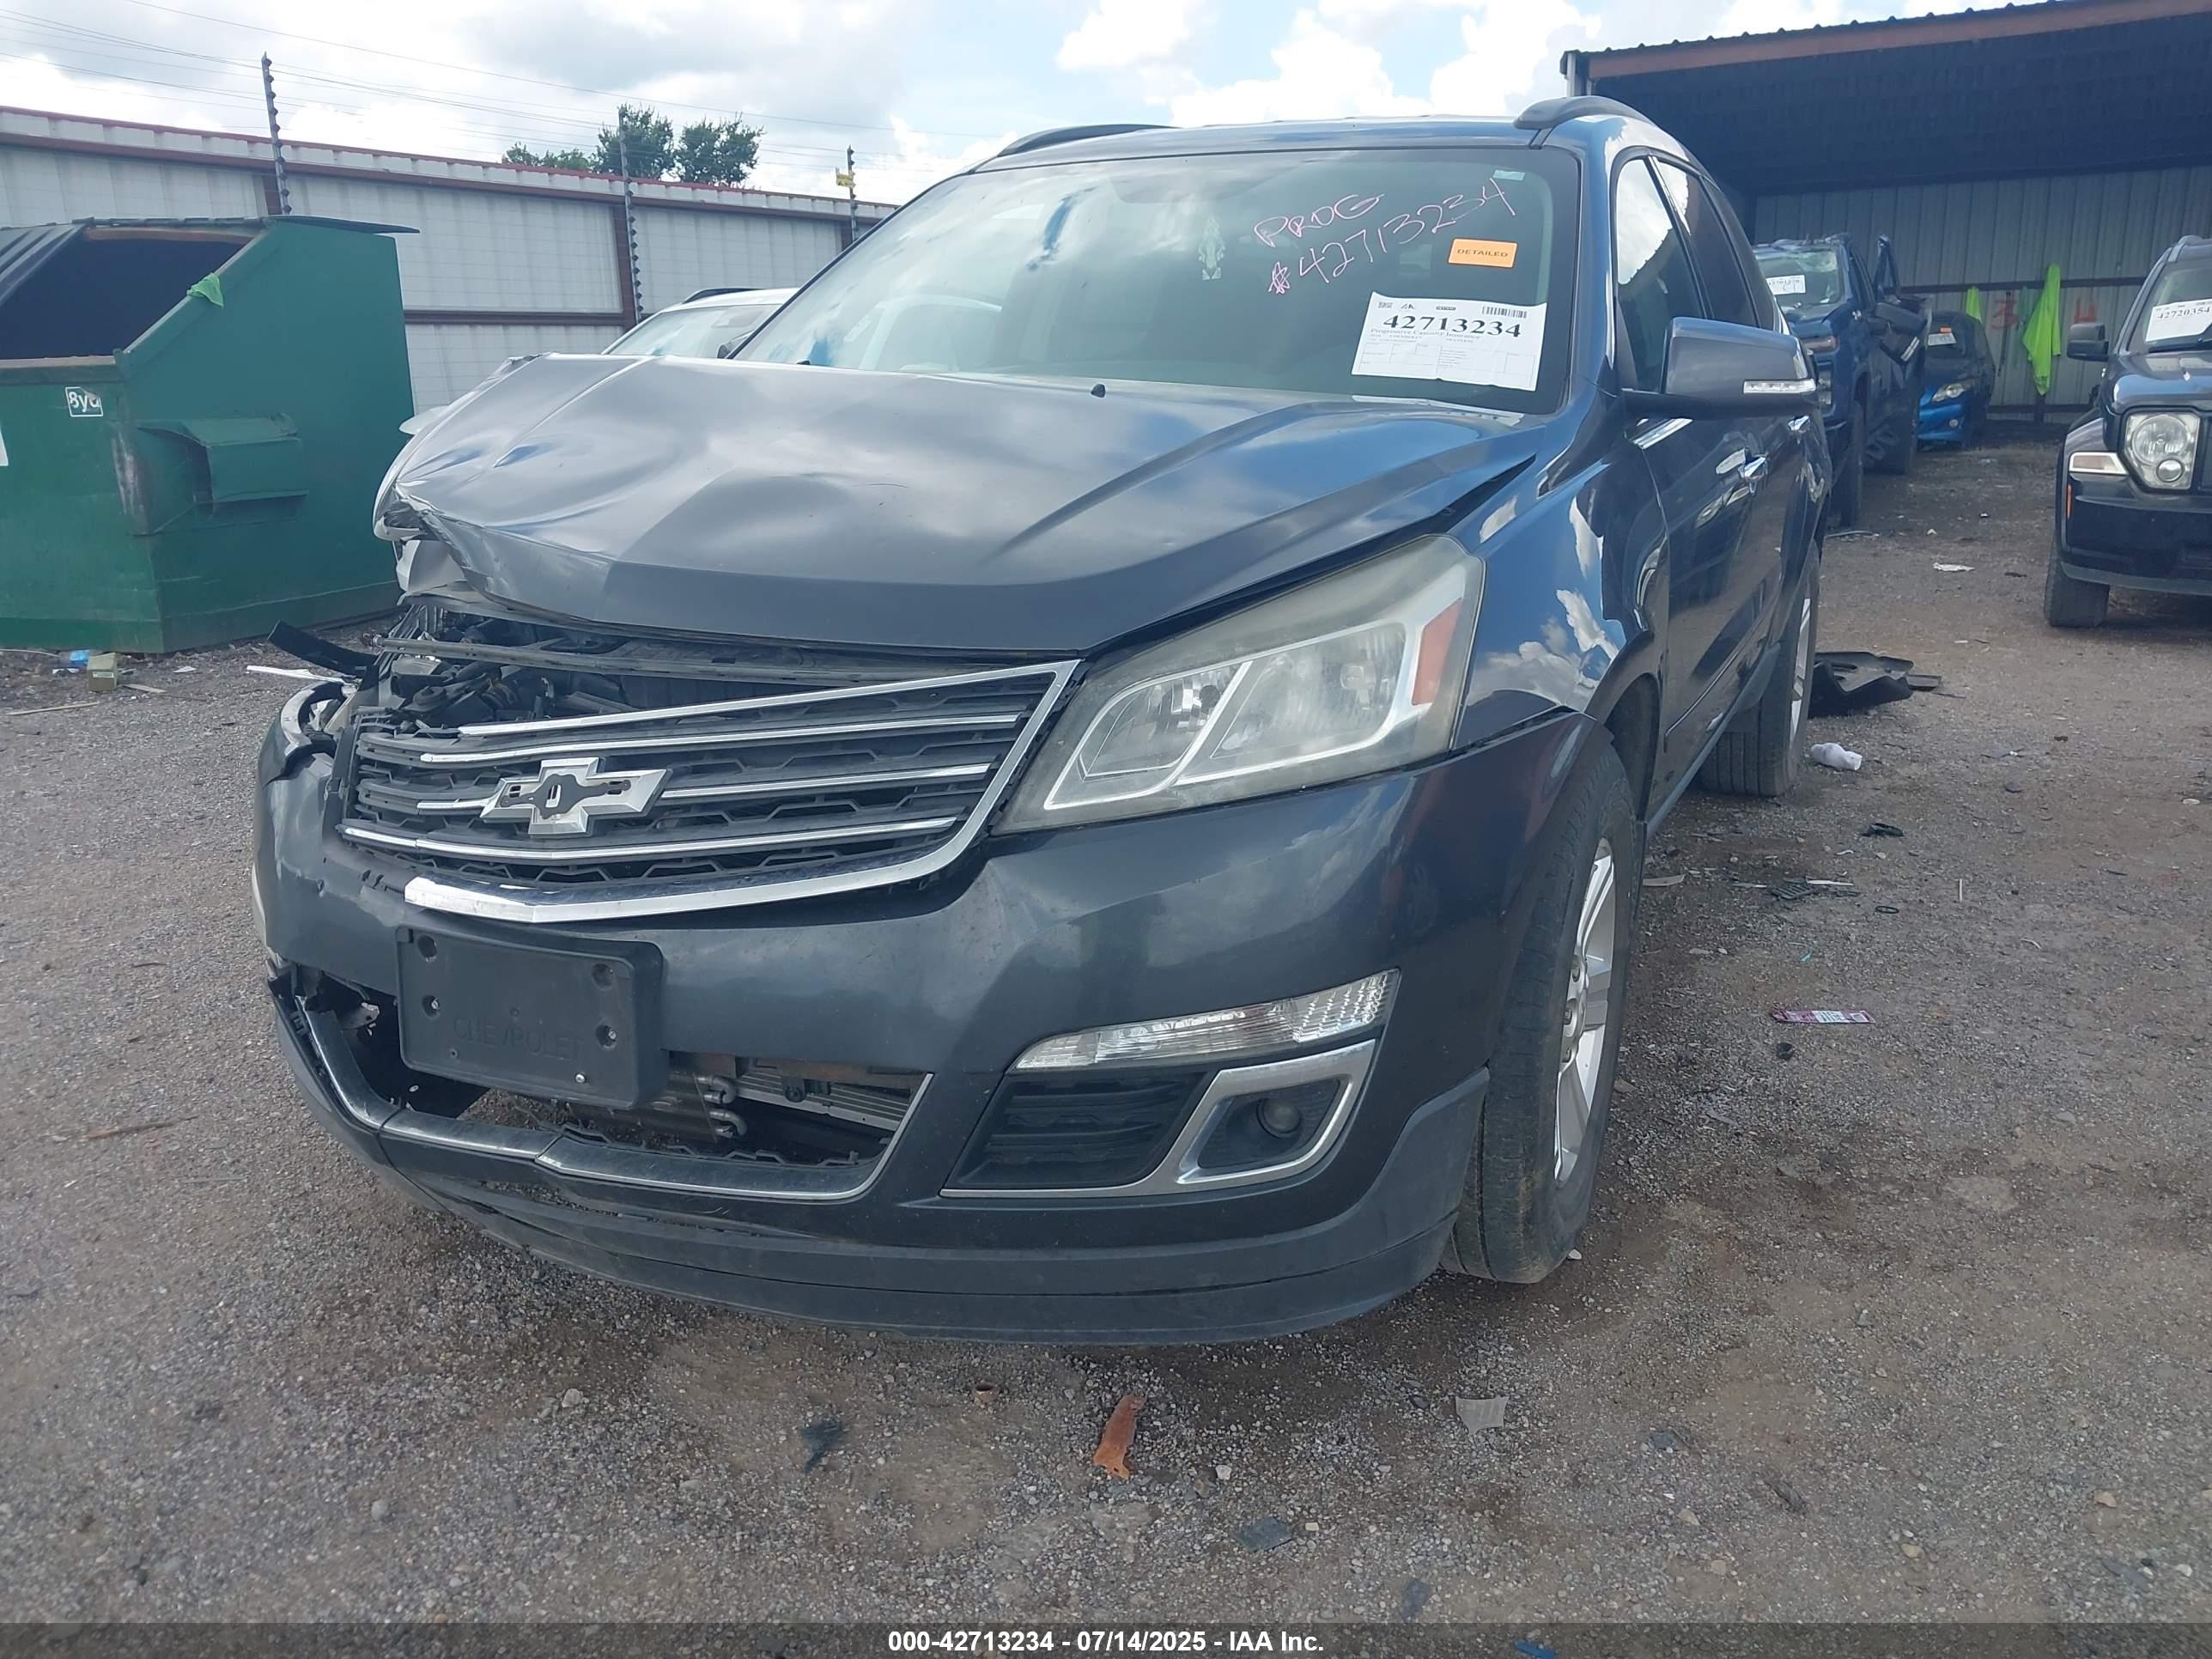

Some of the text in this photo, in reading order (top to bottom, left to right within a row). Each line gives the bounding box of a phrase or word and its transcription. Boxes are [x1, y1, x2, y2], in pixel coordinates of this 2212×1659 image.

[1254, 194, 1385, 248] PROG
[1457, 248, 1509, 258] DETAILED
[2148, 306, 2210, 319] 42720354
[1383, 314, 1522, 337] 42713234
[453, 1016, 585, 1063] CHEVROLET
